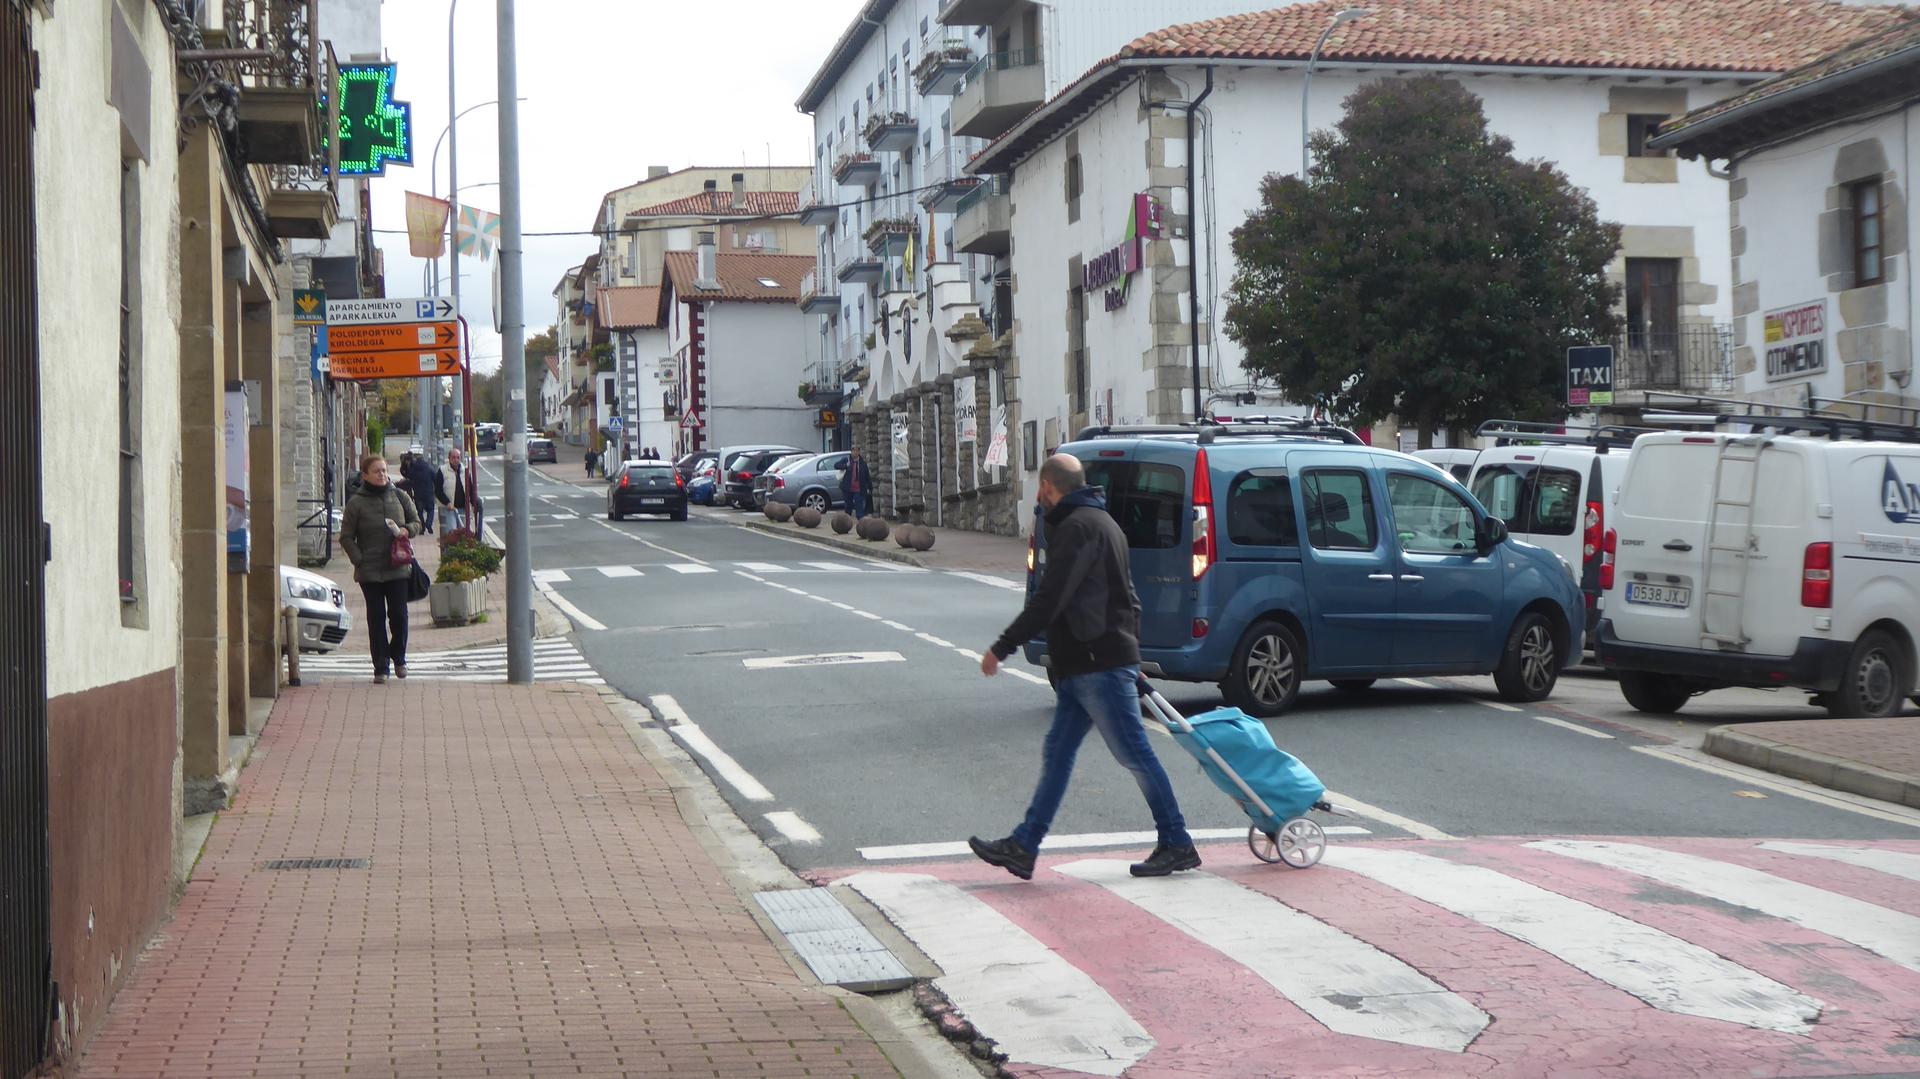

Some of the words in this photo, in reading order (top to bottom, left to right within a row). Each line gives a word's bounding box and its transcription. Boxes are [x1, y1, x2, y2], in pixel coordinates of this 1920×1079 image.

[1083, 246, 1121, 293] LABORAL
[329, 302, 402, 311] APARCAMIENTO
[329, 312, 397, 321] APARKALEKUA
[330, 328, 402, 338] POLIDEPORTIVO
[330, 339, 385, 348] KIROLDEGIA
[332, 356, 376, 365] PISCINAS
[1767, 338, 1824, 376] OTAMENDI
[333, 366, 385, 374] IGERILEKUA
[1570, 366, 1611, 385] TAXI
[1633, 586, 1662, 601] 0538
[1664, 589, 1687, 604] JXJ
